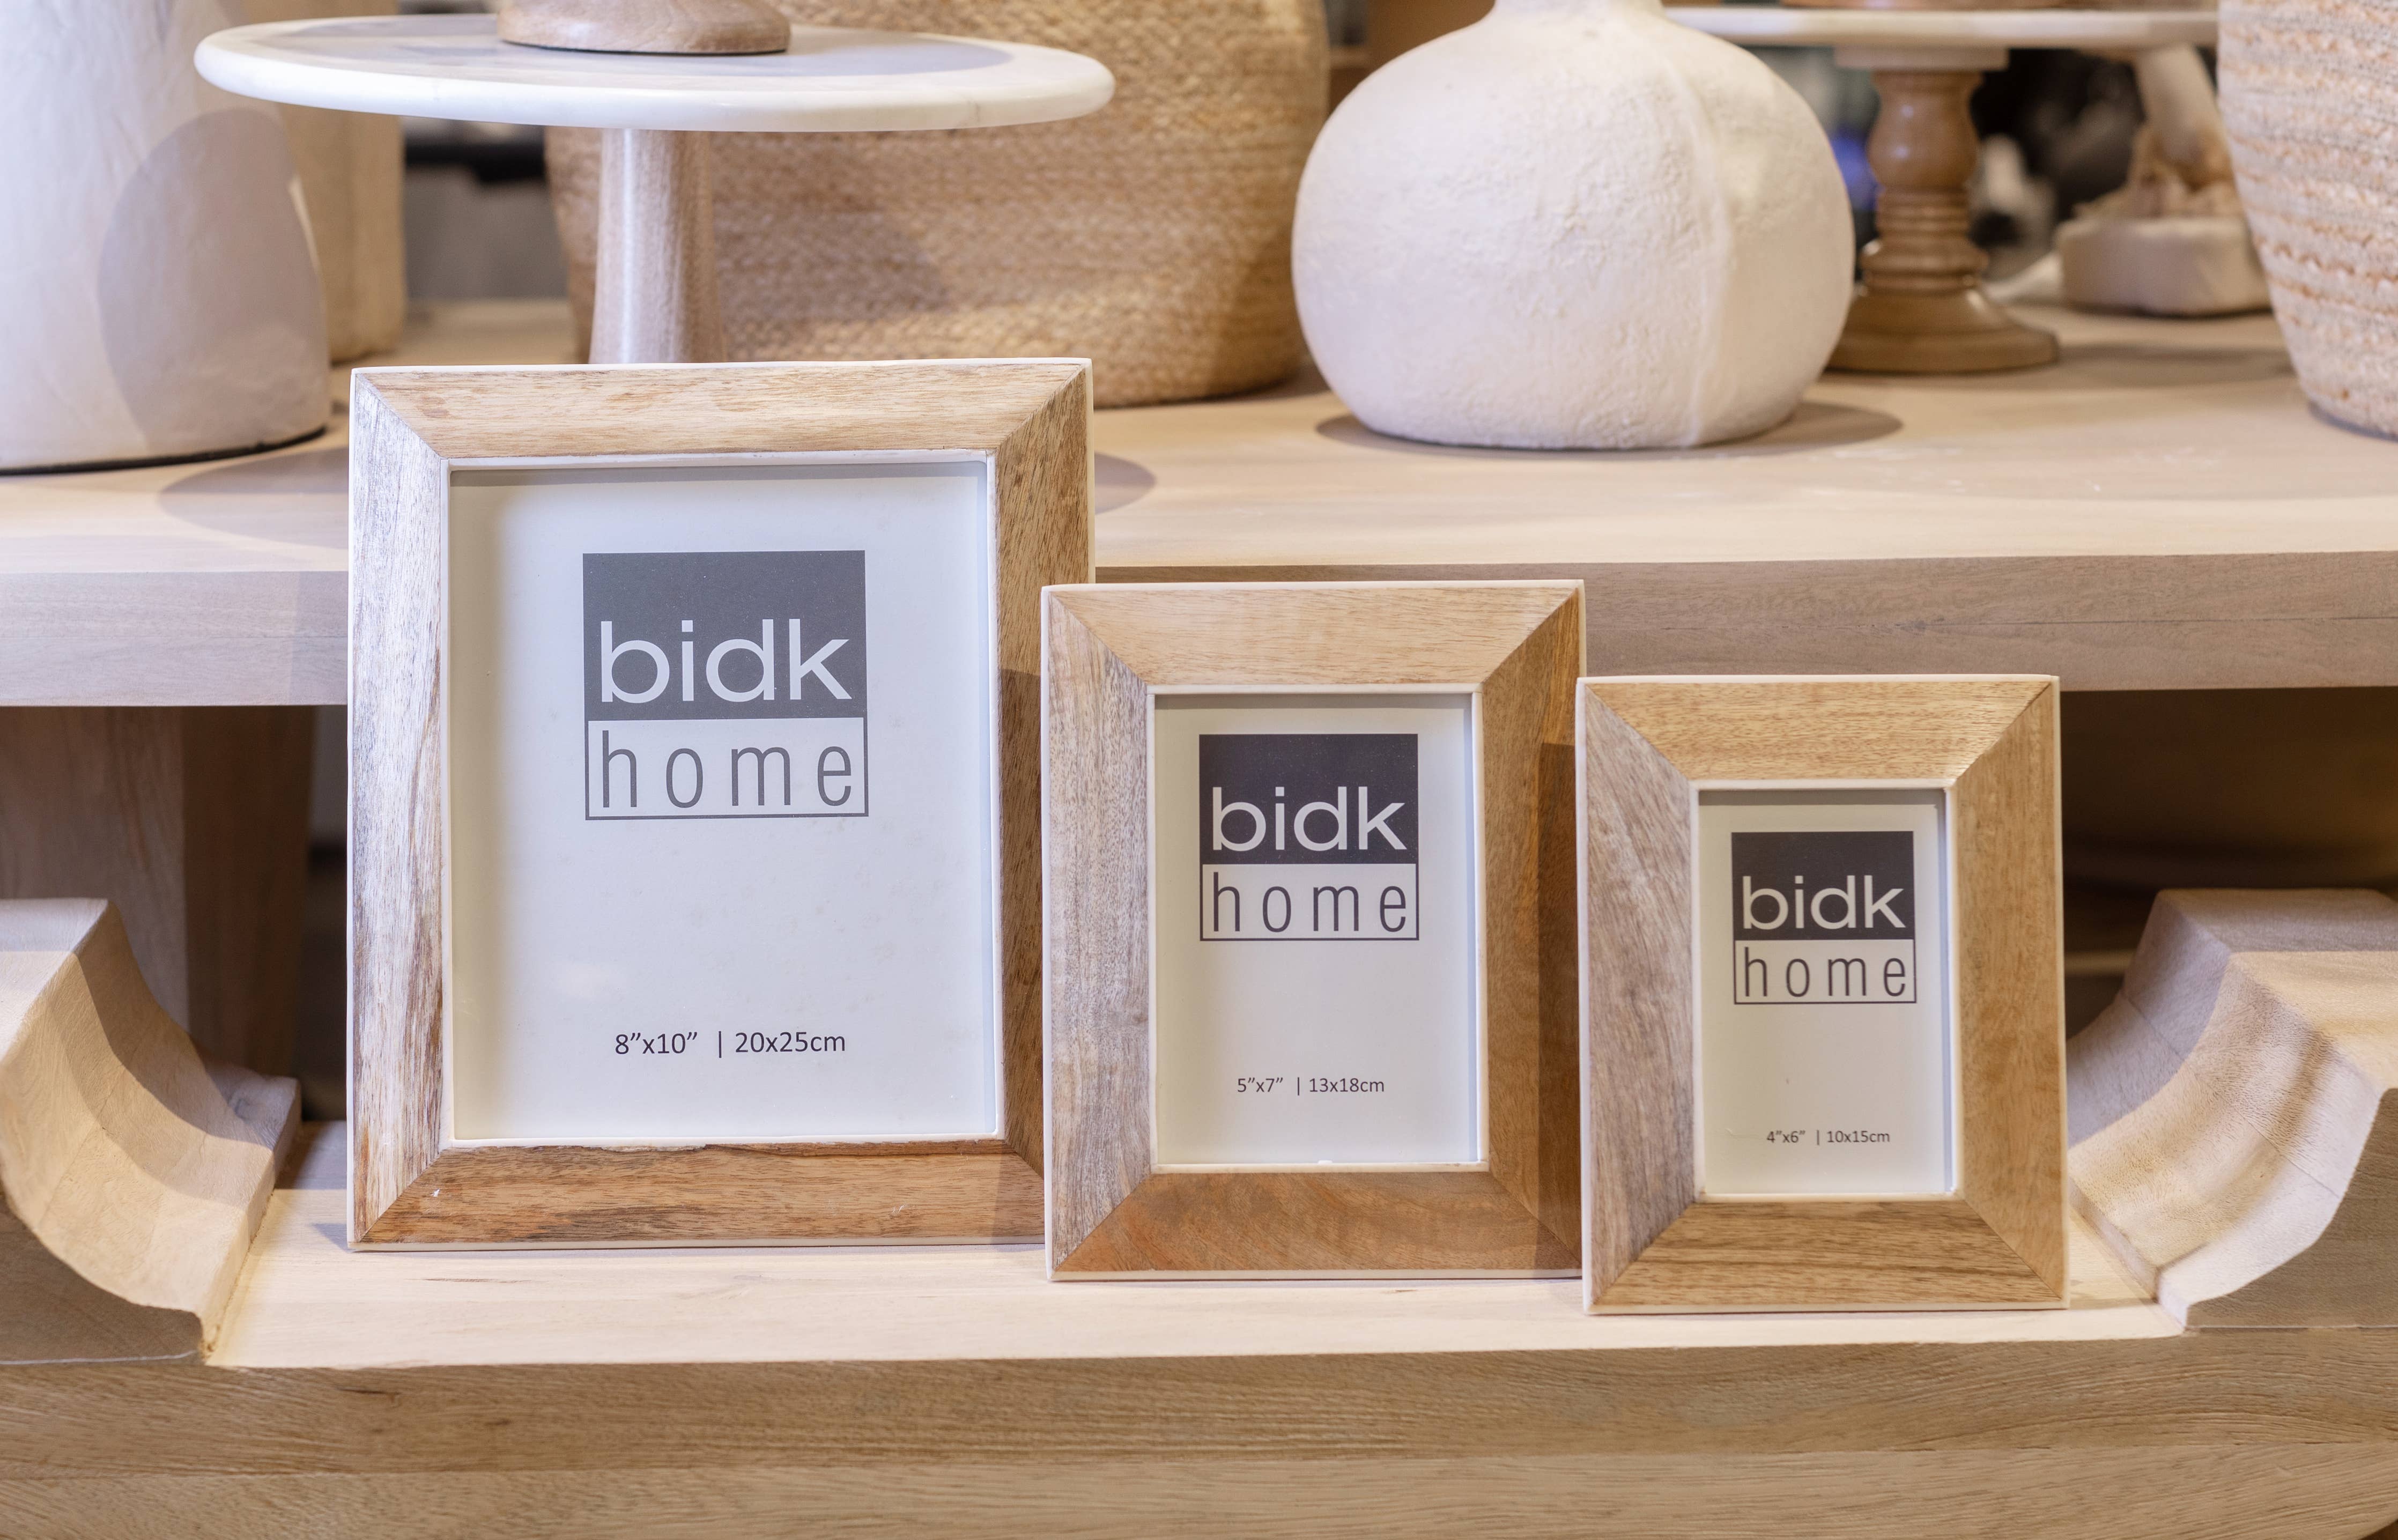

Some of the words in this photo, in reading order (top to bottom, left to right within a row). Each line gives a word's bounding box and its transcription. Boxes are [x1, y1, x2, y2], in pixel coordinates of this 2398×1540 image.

[601, 619, 852, 703] bidk
[603, 730, 852, 808] home
[1213, 787, 1407, 851] bidk
[1213, 872, 1406, 932] home
[1743, 875, 1906, 929] bidk
[1744, 947, 1905, 997] home
[735, 1032, 845, 1053] 20x25cm
[1309, 1077, 1385, 1092] 13x18cm
[1827, 1130, 1890, 1143] 10x15cm
